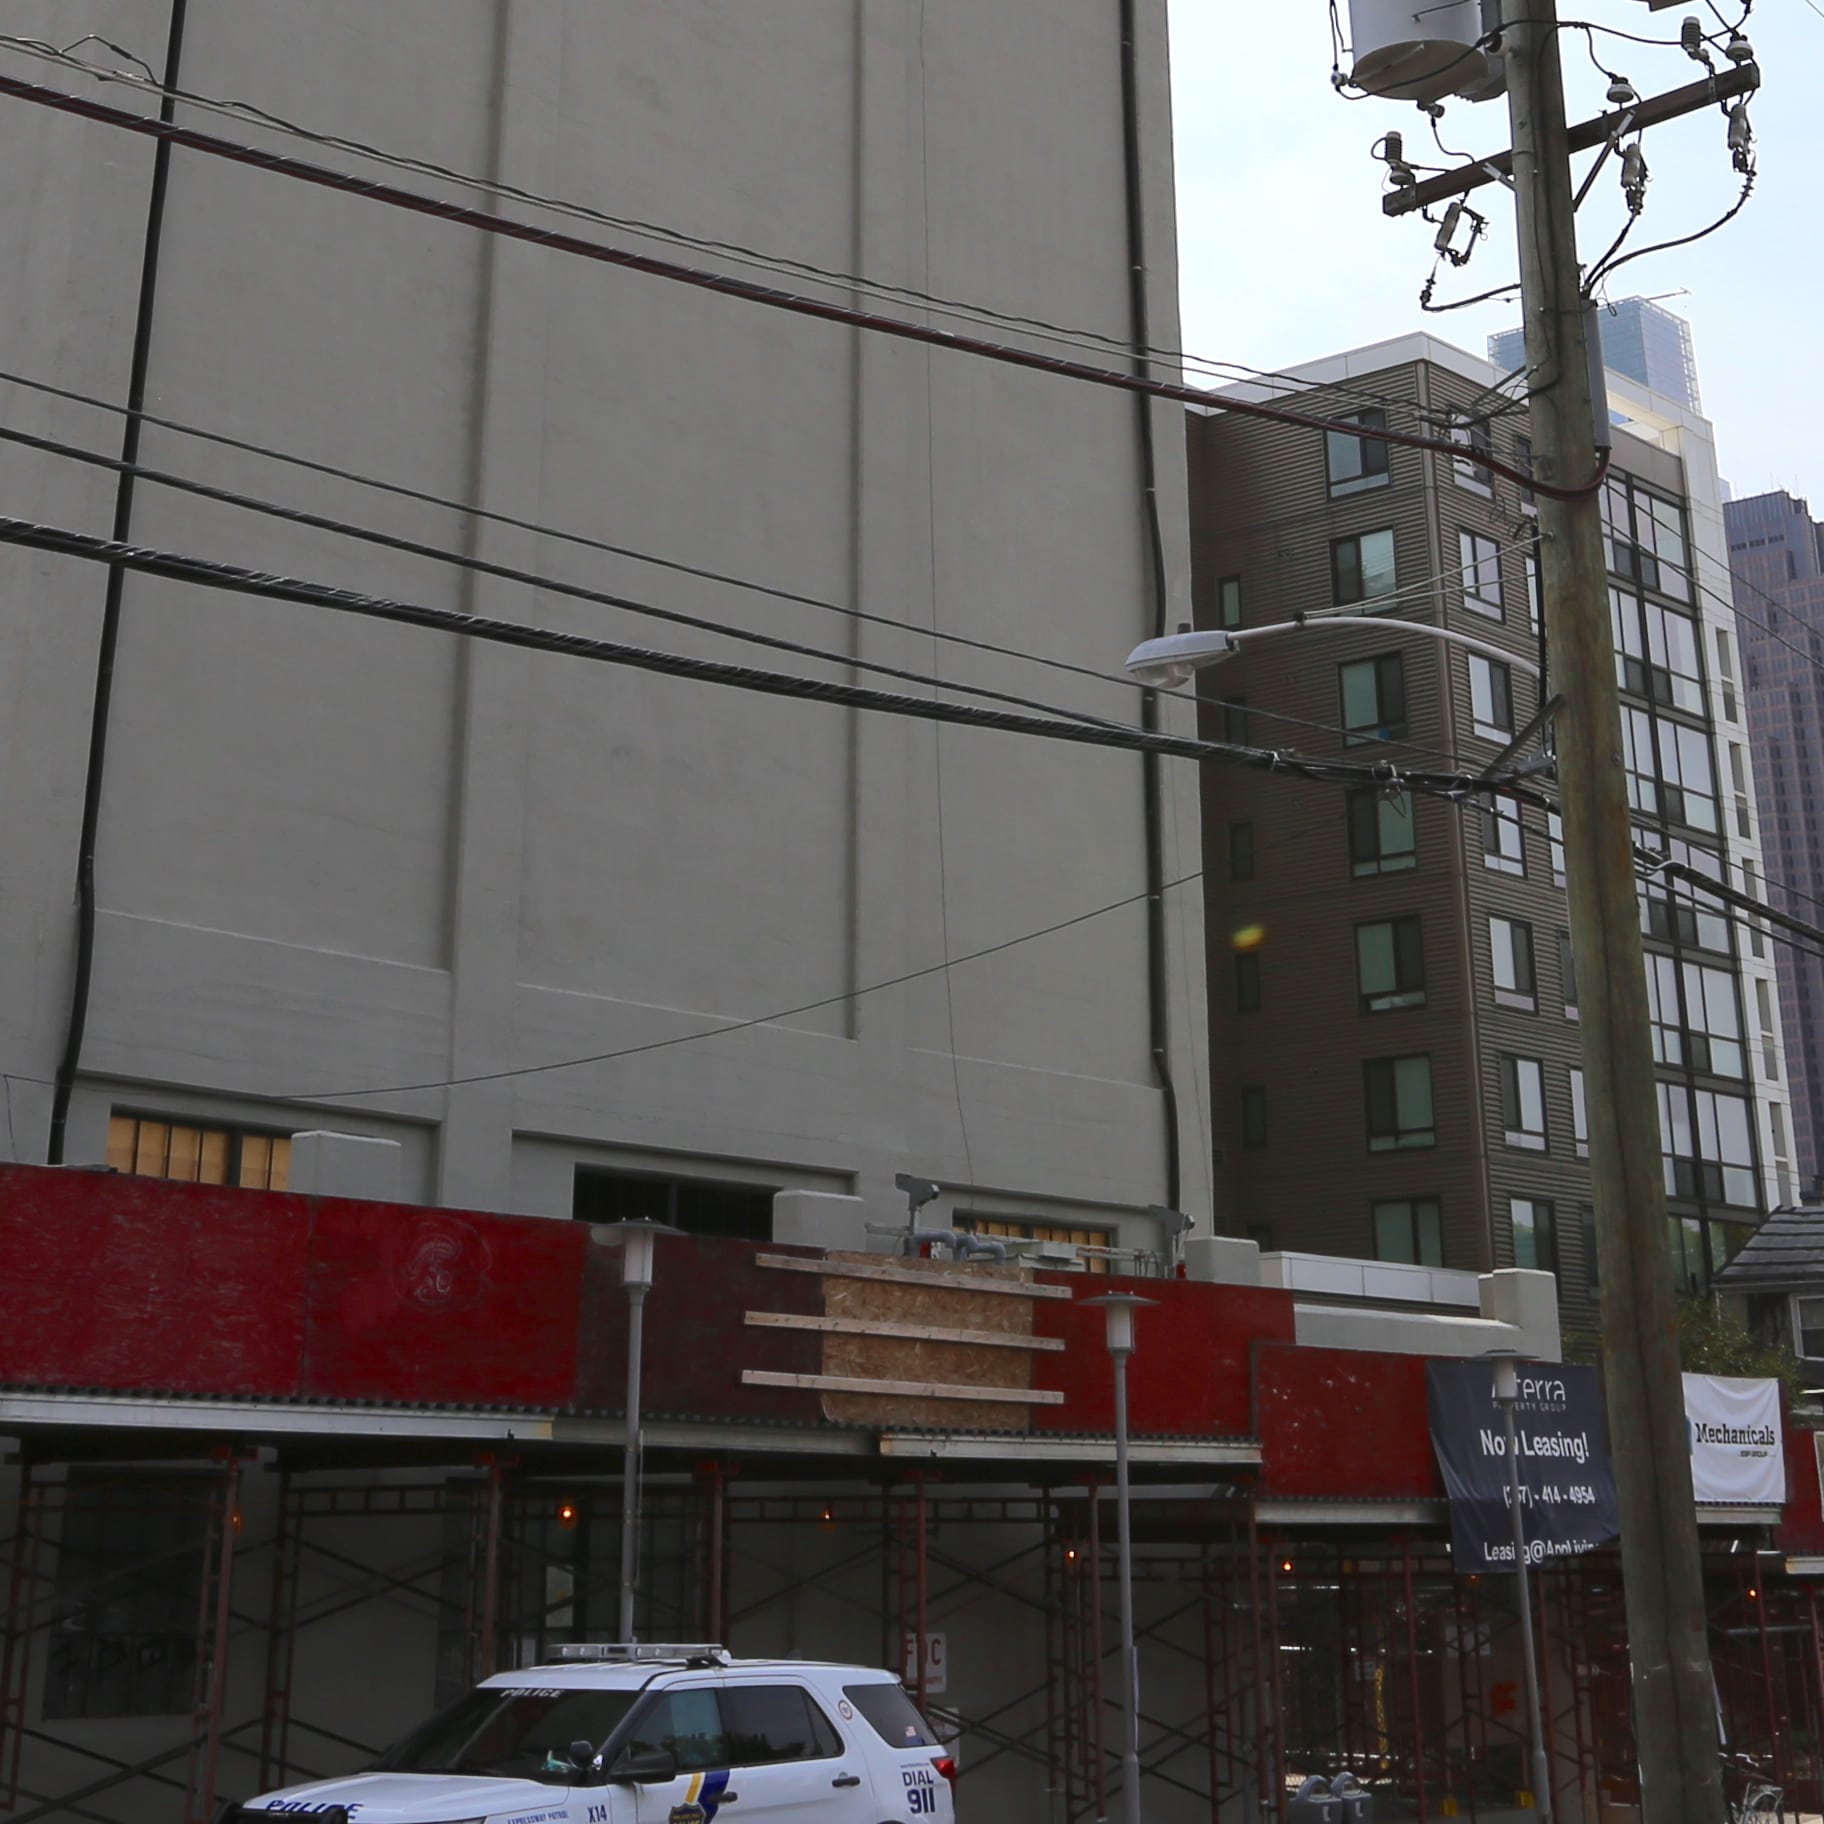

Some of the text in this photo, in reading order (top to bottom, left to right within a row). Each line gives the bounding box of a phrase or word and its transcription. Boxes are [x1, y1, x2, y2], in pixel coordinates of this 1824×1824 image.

[1491, 1371, 1566, 1402] terra
[1492, 1401, 1567, 1413] PERTY GROUP
[1695, 1423, 1776, 1446] Mechanicals
[1521, 1430, 1590, 1464] Leasing!
[1542, 1485, 1561, 1504] 414
[1569, 1485, 1596, 1505] 4954
[904, 1638, 942, 1666] FC
[500, 1688, 565, 1698] POLICE
[902, 1770, 934, 1787] DIAL
[907, 1787, 936, 1815] 911
[587, 1803, 608, 1824] X14
